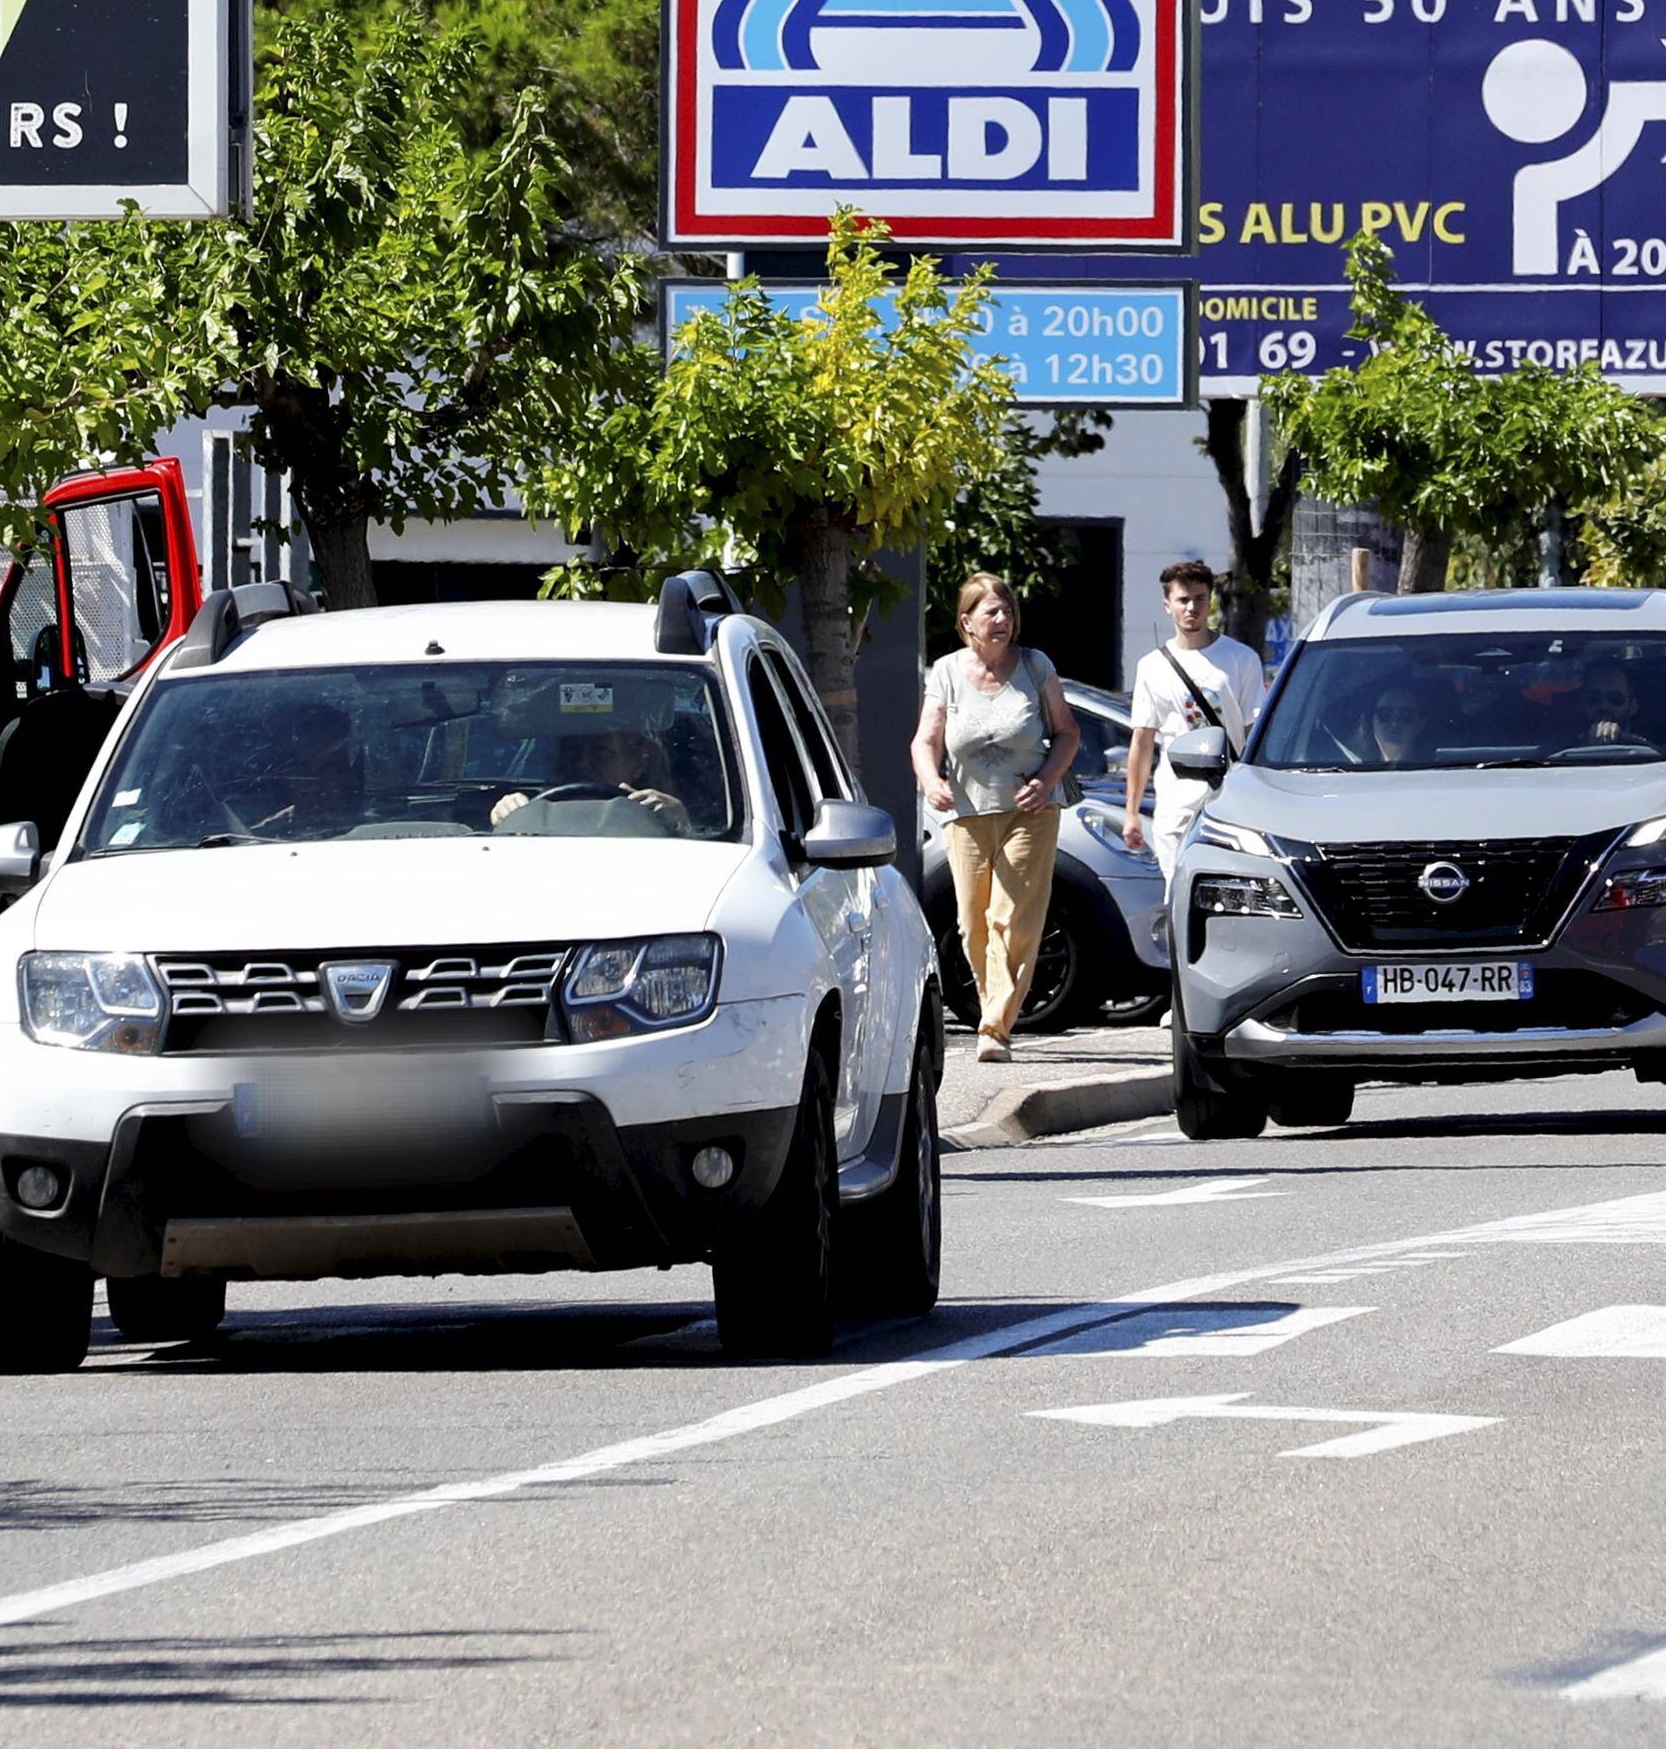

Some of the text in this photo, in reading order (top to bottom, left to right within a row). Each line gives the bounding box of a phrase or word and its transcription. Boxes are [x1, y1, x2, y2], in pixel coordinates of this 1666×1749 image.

[113, 102, 129, 149] !
[749, 95, 1088, 181] ALDI
[1199, 203, 1466, 245] S ALU PVC
[1567, 230, 1601, 277] À
[1007, 307, 1029, 338] à
[1043, 306, 1165, 338] 20h00
[1199, 297, 1318, 321] OMICILE
[1199, 331, 1228, 370] 1
[1259, 330, 1317, 370] 69
[1008, 353, 1028, 384] à
[1044, 354, 1165, 385] 12h30
[1418, 877, 1470, 888] NISSAN
[337, 973, 380, 983] DACIA
[1383, 965, 1513, 994] HB-047-RR
